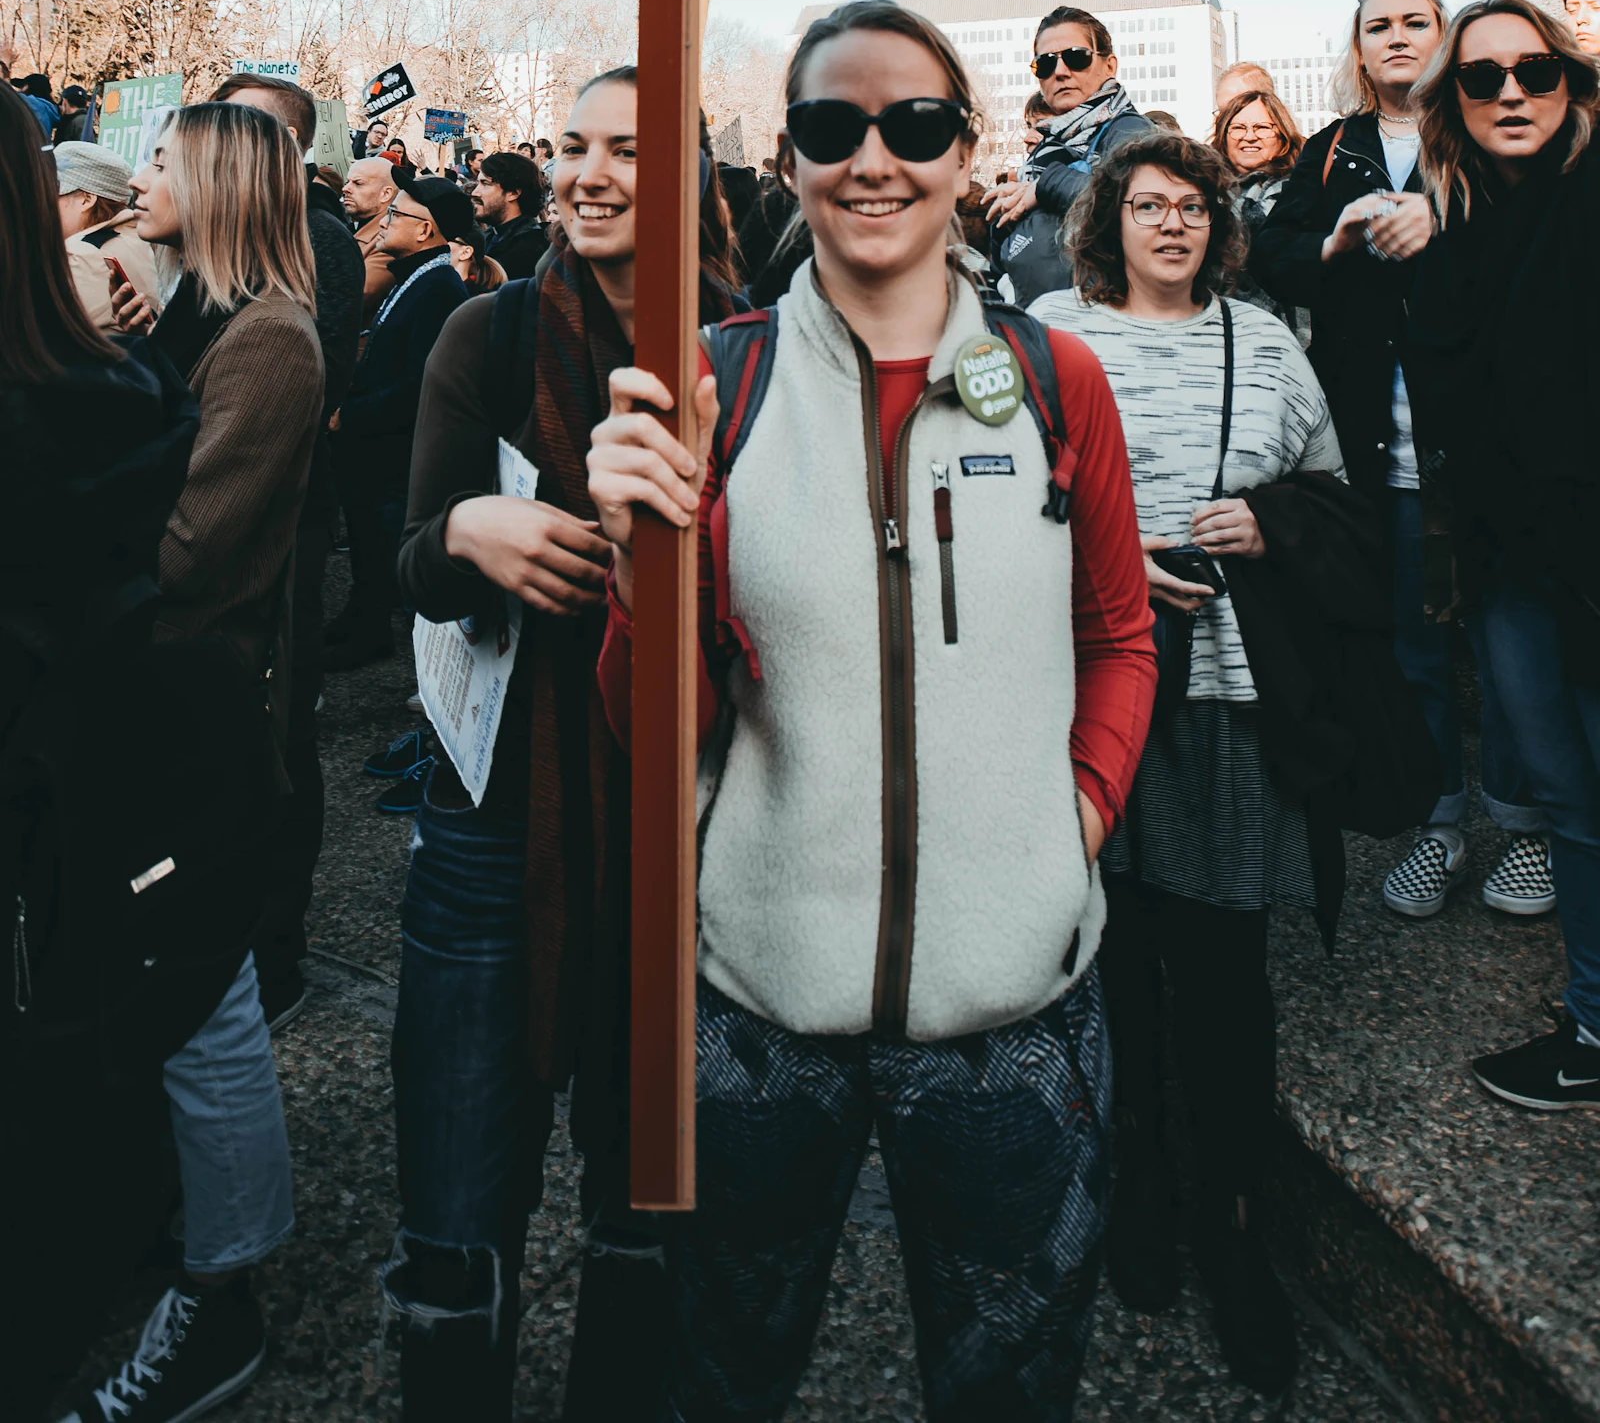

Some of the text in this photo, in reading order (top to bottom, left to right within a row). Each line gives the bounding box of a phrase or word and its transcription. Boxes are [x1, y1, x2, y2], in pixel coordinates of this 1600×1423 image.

[237, 61, 298, 75] The planets
[121, 83, 166, 120] THE
[366, 84, 408, 113] ENERGY
[962, 349, 1011, 376] Natalie
[967, 366, 1015, 399] ODD
